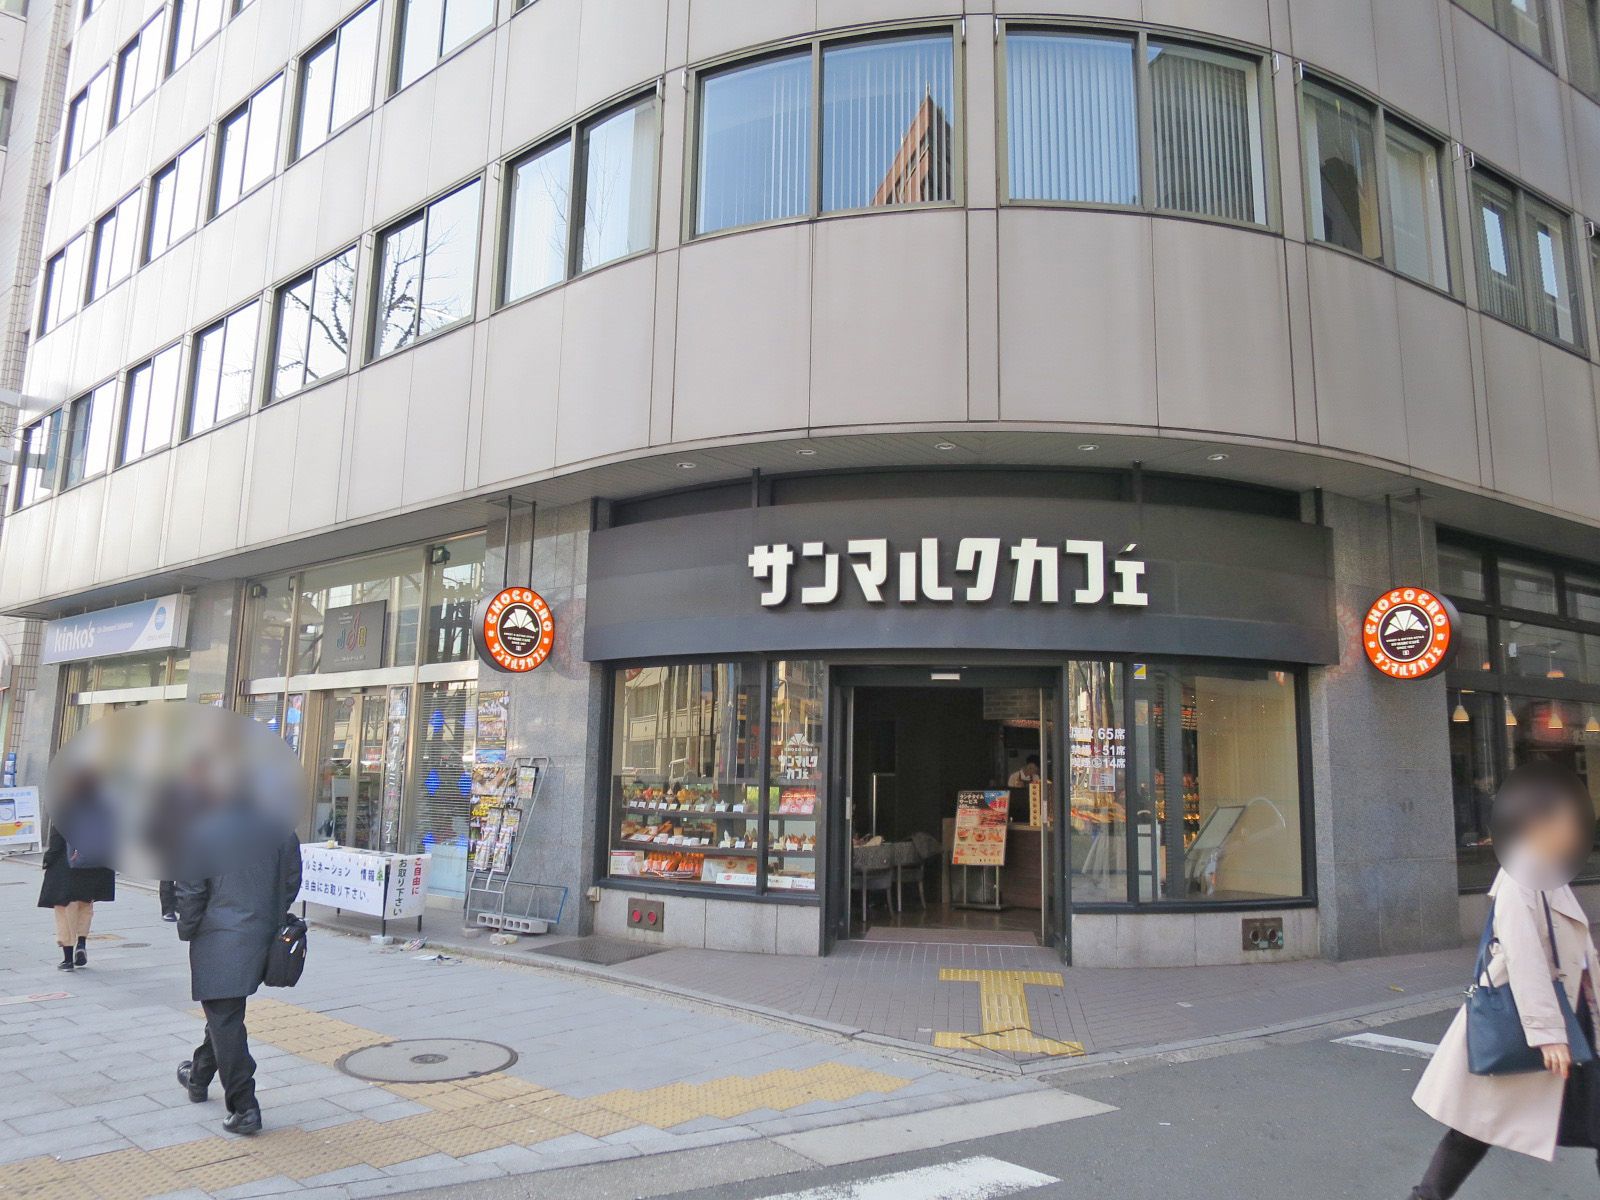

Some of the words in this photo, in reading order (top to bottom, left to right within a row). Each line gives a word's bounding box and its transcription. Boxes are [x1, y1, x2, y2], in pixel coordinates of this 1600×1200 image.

[748, 537, 1148, 606] サンマルクカフェ
[486, 589, 552, 632] CHOCOCRO
[1365, 589, 1446, 635] CHOCOCRO
[54, 620, 96, 652] kinko's
[490, 643, 547, 670] サンマルクカフェ
[1374, 646, 1443, 676] サンマルクカフェ
[1098, 727, 1126, 740] 65席
[302, 860, 351, 877] ルミネーション
[411, 857, 422, 895] ご自由に
[393, 859, 407, 916] お取り下さい
